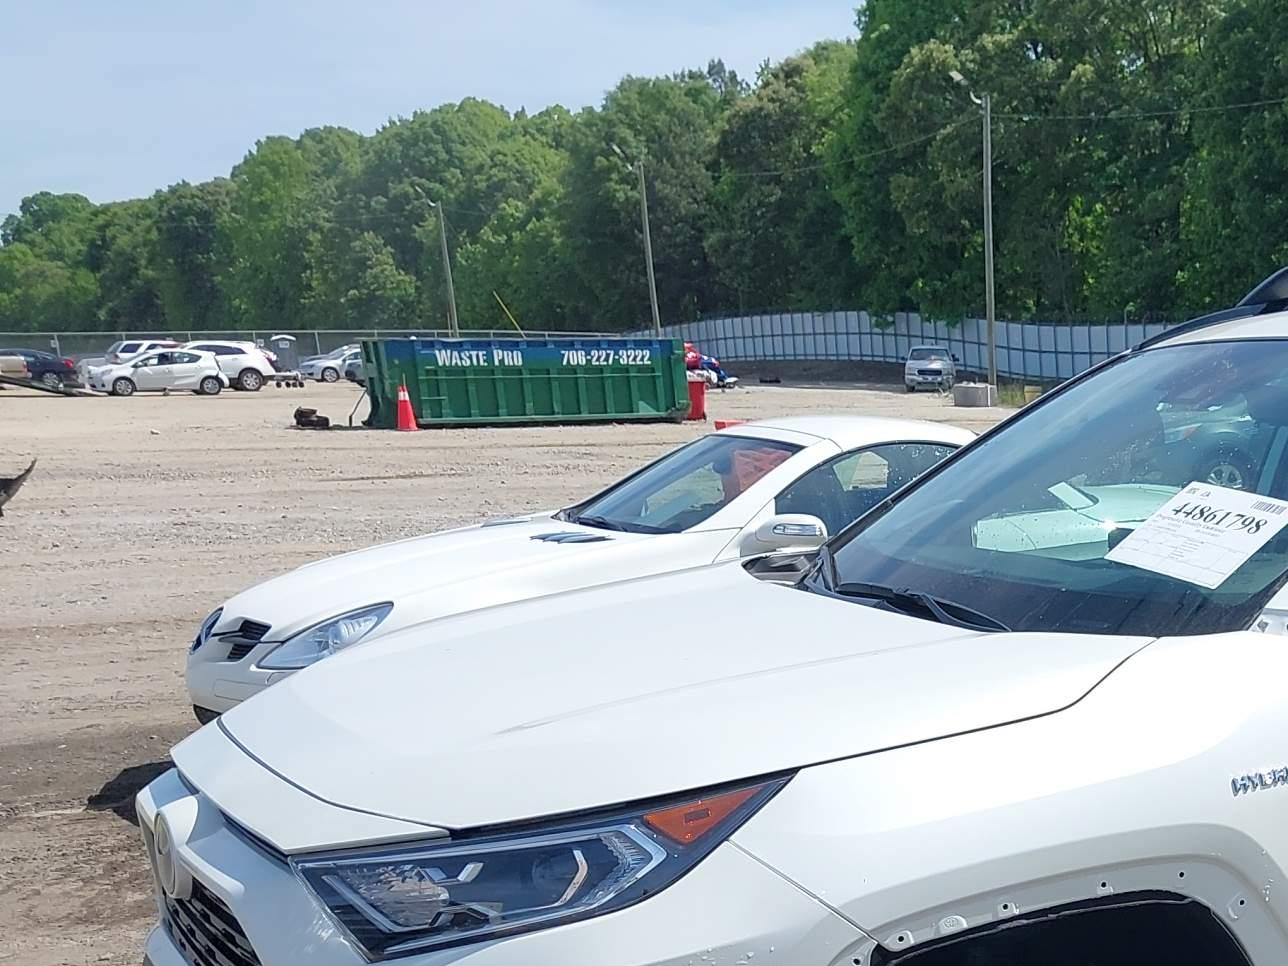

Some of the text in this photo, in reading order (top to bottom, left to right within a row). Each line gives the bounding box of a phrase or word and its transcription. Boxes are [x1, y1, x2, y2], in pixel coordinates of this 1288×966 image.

[434, 350, 524, 367] WASTE PRO
[560, 349, 652, 366] 706-227-3222
[1171, 501, 1269, 535] 44861798
